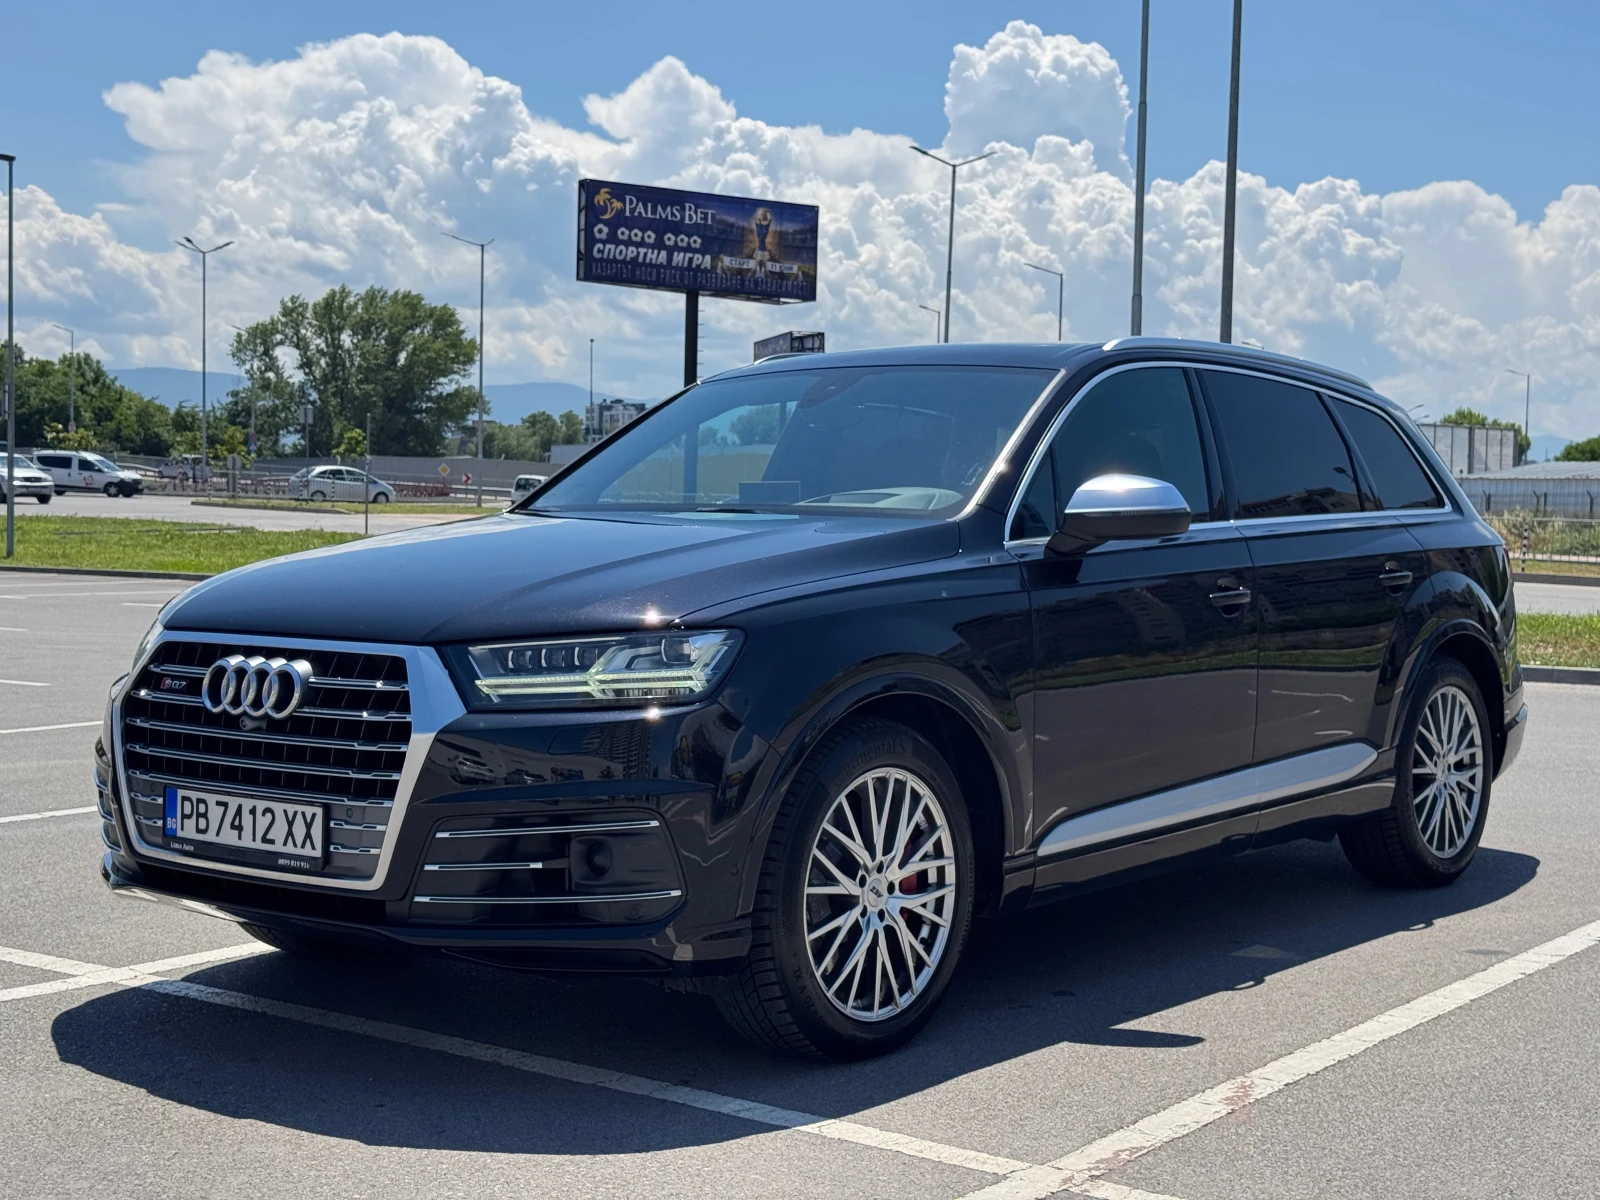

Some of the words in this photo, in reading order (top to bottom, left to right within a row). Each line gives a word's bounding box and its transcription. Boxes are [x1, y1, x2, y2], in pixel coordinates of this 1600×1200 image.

[592, 243, 668, 266] СПОРТНА
[671, 251, 712, 270] ИГРА
[729, 258, 750, 267] СТАРТ
[167, 817, 177, 829] BG
